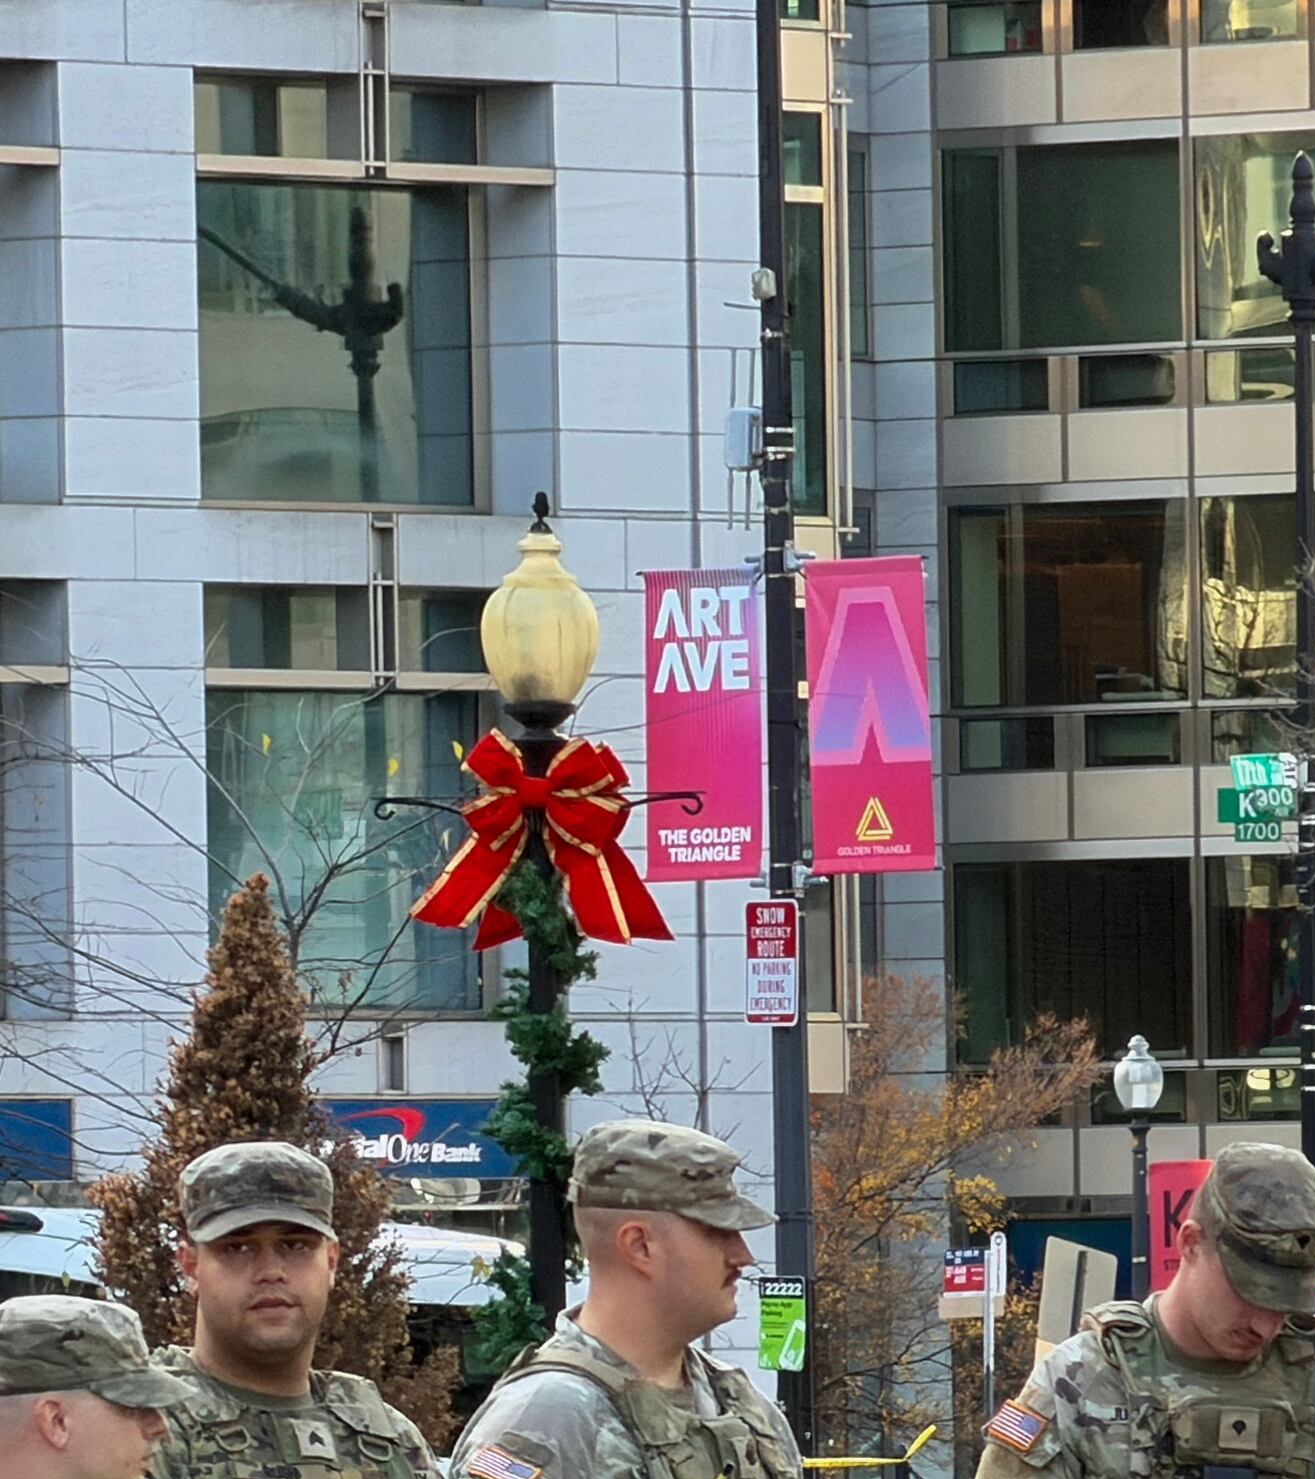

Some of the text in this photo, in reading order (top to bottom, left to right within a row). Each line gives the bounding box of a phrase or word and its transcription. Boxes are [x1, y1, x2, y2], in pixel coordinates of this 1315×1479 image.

[654, 586, 751, 638] ART
[654, 641, 749, 693] AVE
[1239, 793, 1257, 818] K
[659, 827, 751, 846] THE GOLDEN
[1238, 823, 1279, 839] 1700
[668, 845, 741, 862] TRIANGLE
[838, 845, 911, 856] GOLDEN TRIANGLE
[756, 907, 785, 924] SNOW
[757, 940, 785, 956] ROUTE
[431, 1143, 482, 1162] Bank
[765, 1283, 802, 1295] 22222
